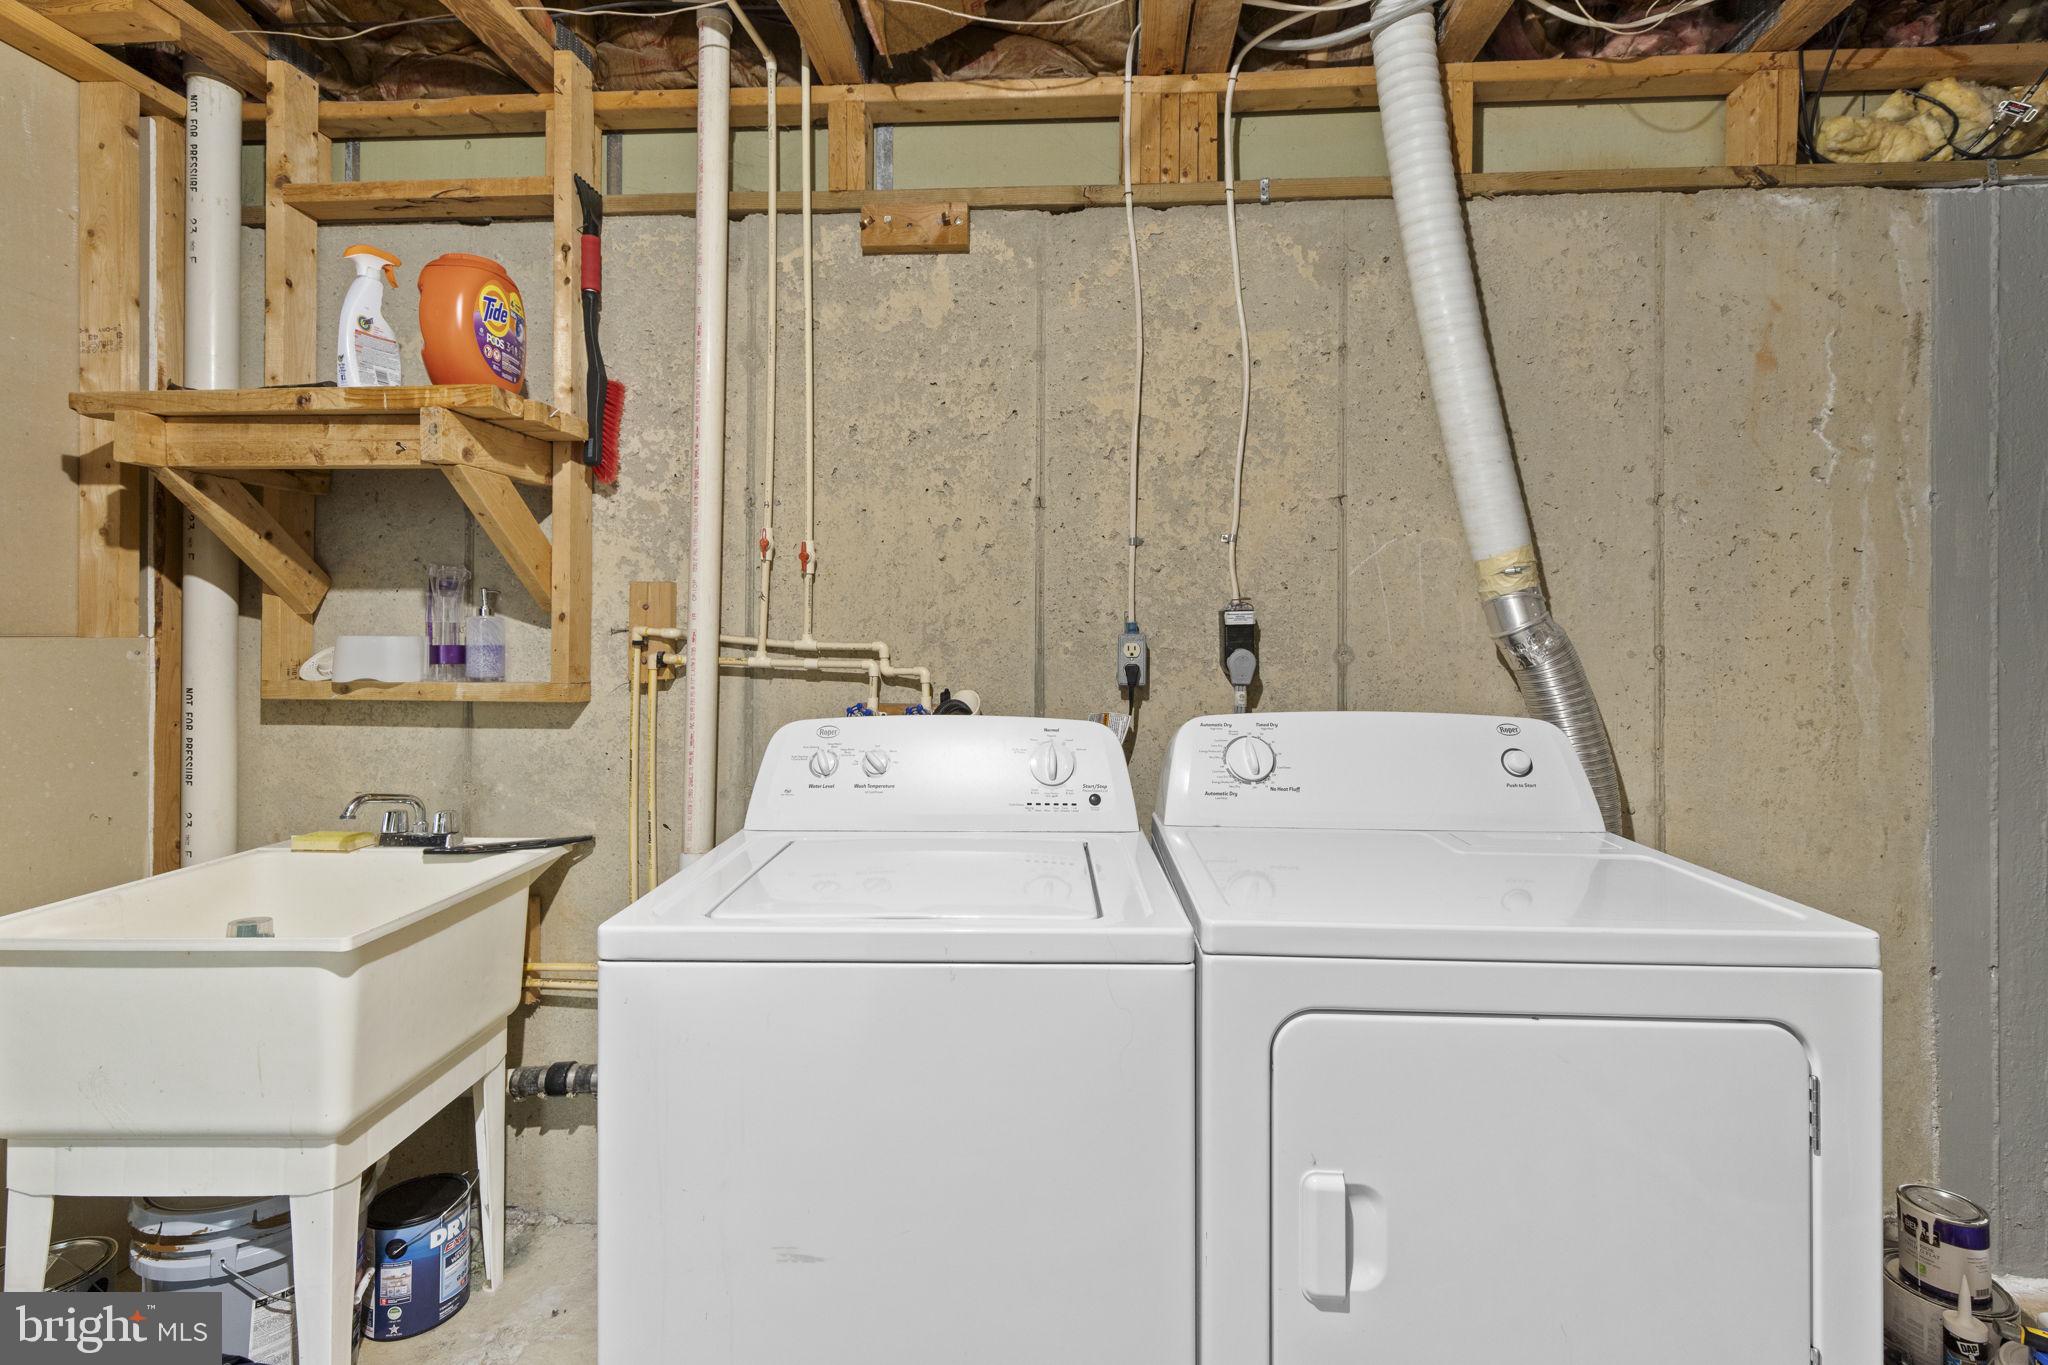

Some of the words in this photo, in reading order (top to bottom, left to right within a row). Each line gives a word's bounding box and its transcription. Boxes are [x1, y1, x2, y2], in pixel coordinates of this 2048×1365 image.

[483, 295, 508, 324] Tide
[486, 332, 505, 350] PODS
[819, 728, 837, 736] Roper
[1960, 1343, 1978, 1354] DAP
